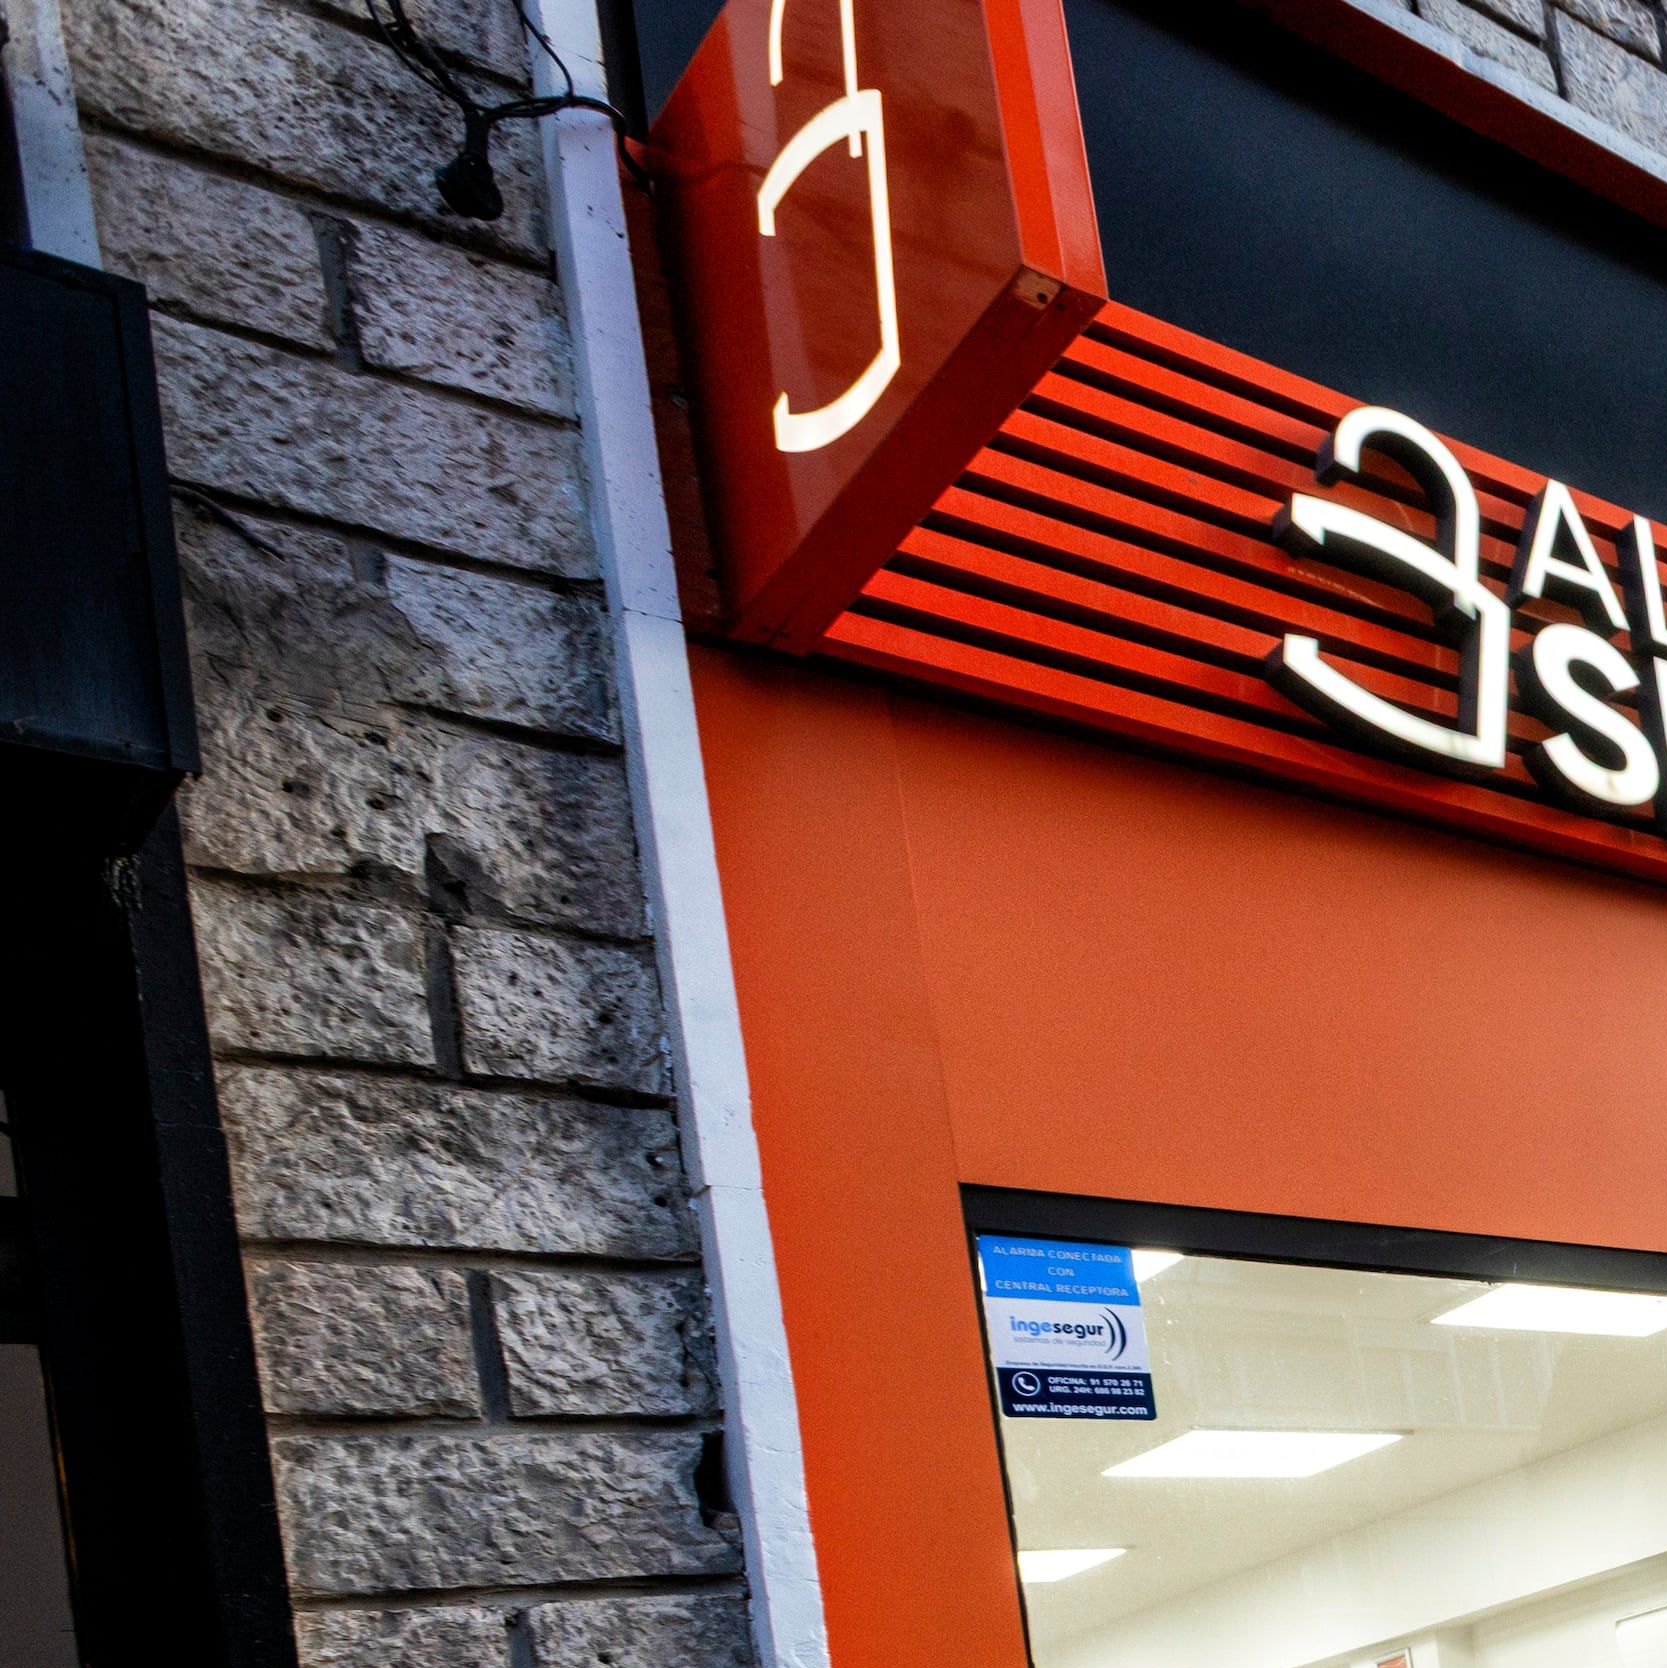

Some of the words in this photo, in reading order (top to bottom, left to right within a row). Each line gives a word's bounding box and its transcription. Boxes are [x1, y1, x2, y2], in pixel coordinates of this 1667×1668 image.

[993, 1245, 1045, 1258] ALARMA
[1047, 1250, 1122, 1264] CONECTADA
[1047, 1266, 1075, 1278] CON
[995, 1280, 1052, 1293] CENTRAL
[1055, 1283, 1130, 1298] RECEPTORA
[1009, 1315, 1104, 1339] ingesegur
[1048, 1376, 1088, 1386] OFICINA:
[1089, 1377, 1100, 1386] 91
[1132, 1379, 1143, 1388] 71
[1049, 1385, 1071, 1394] URG.
[1012, 1401, 1148, 1416] www.ingesegur.com
